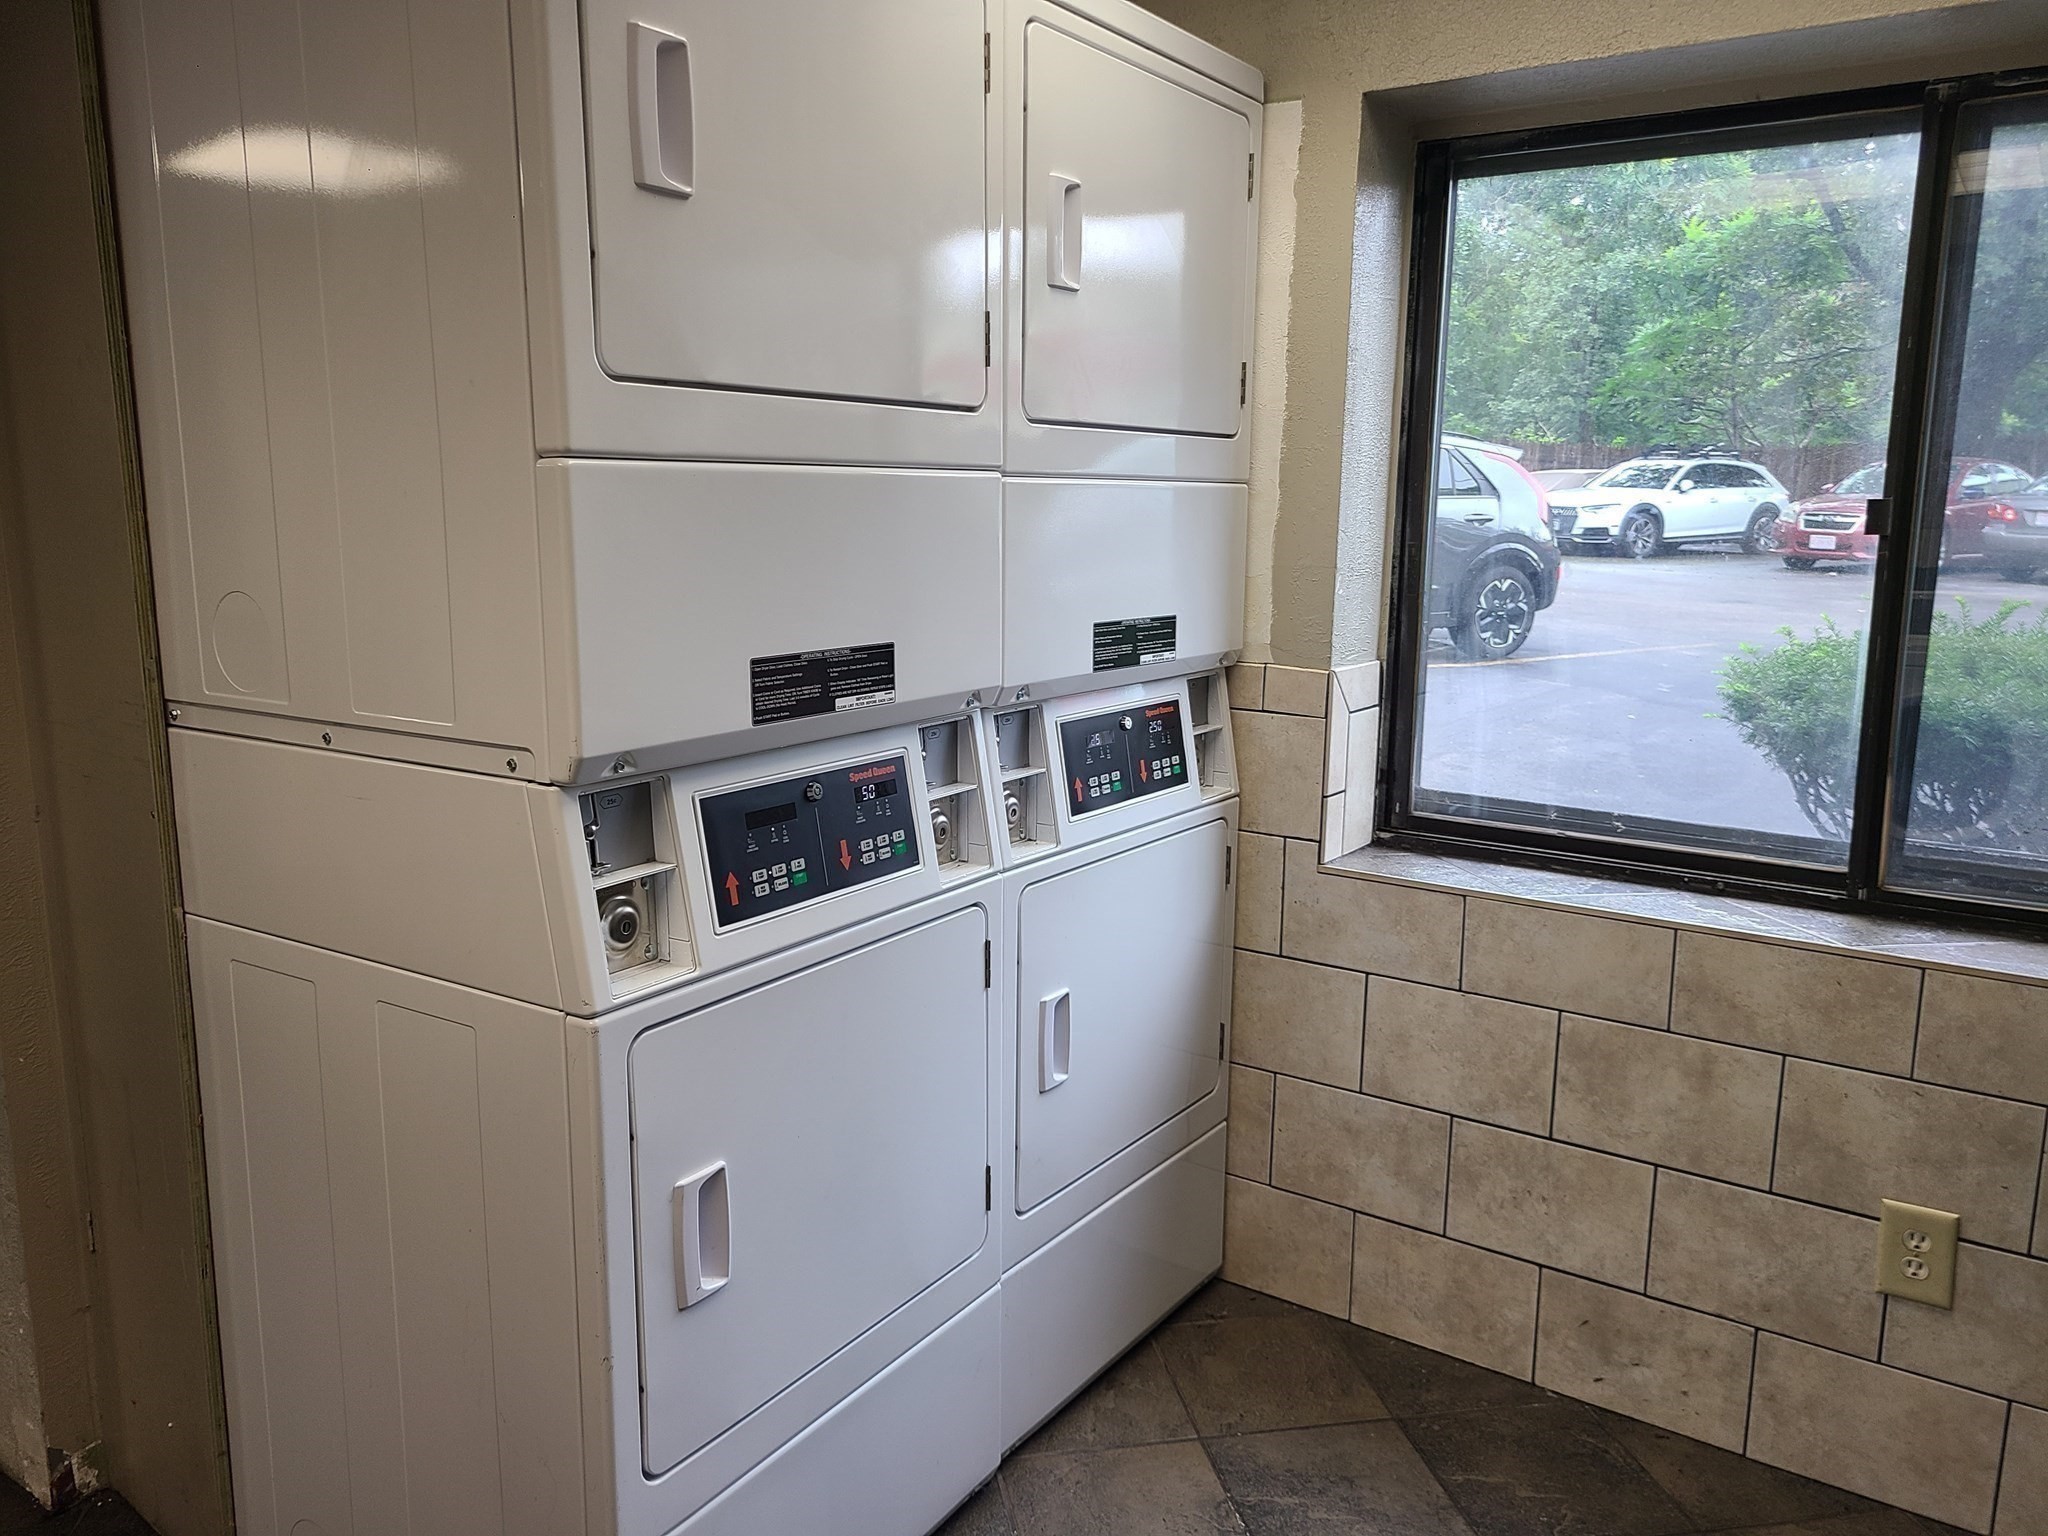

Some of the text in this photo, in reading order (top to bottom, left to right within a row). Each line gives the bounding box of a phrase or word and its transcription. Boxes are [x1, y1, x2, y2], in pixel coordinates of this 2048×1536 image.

[849, 765, 896, 782] Speed Queen
[862, 784, 876, 801] 50
